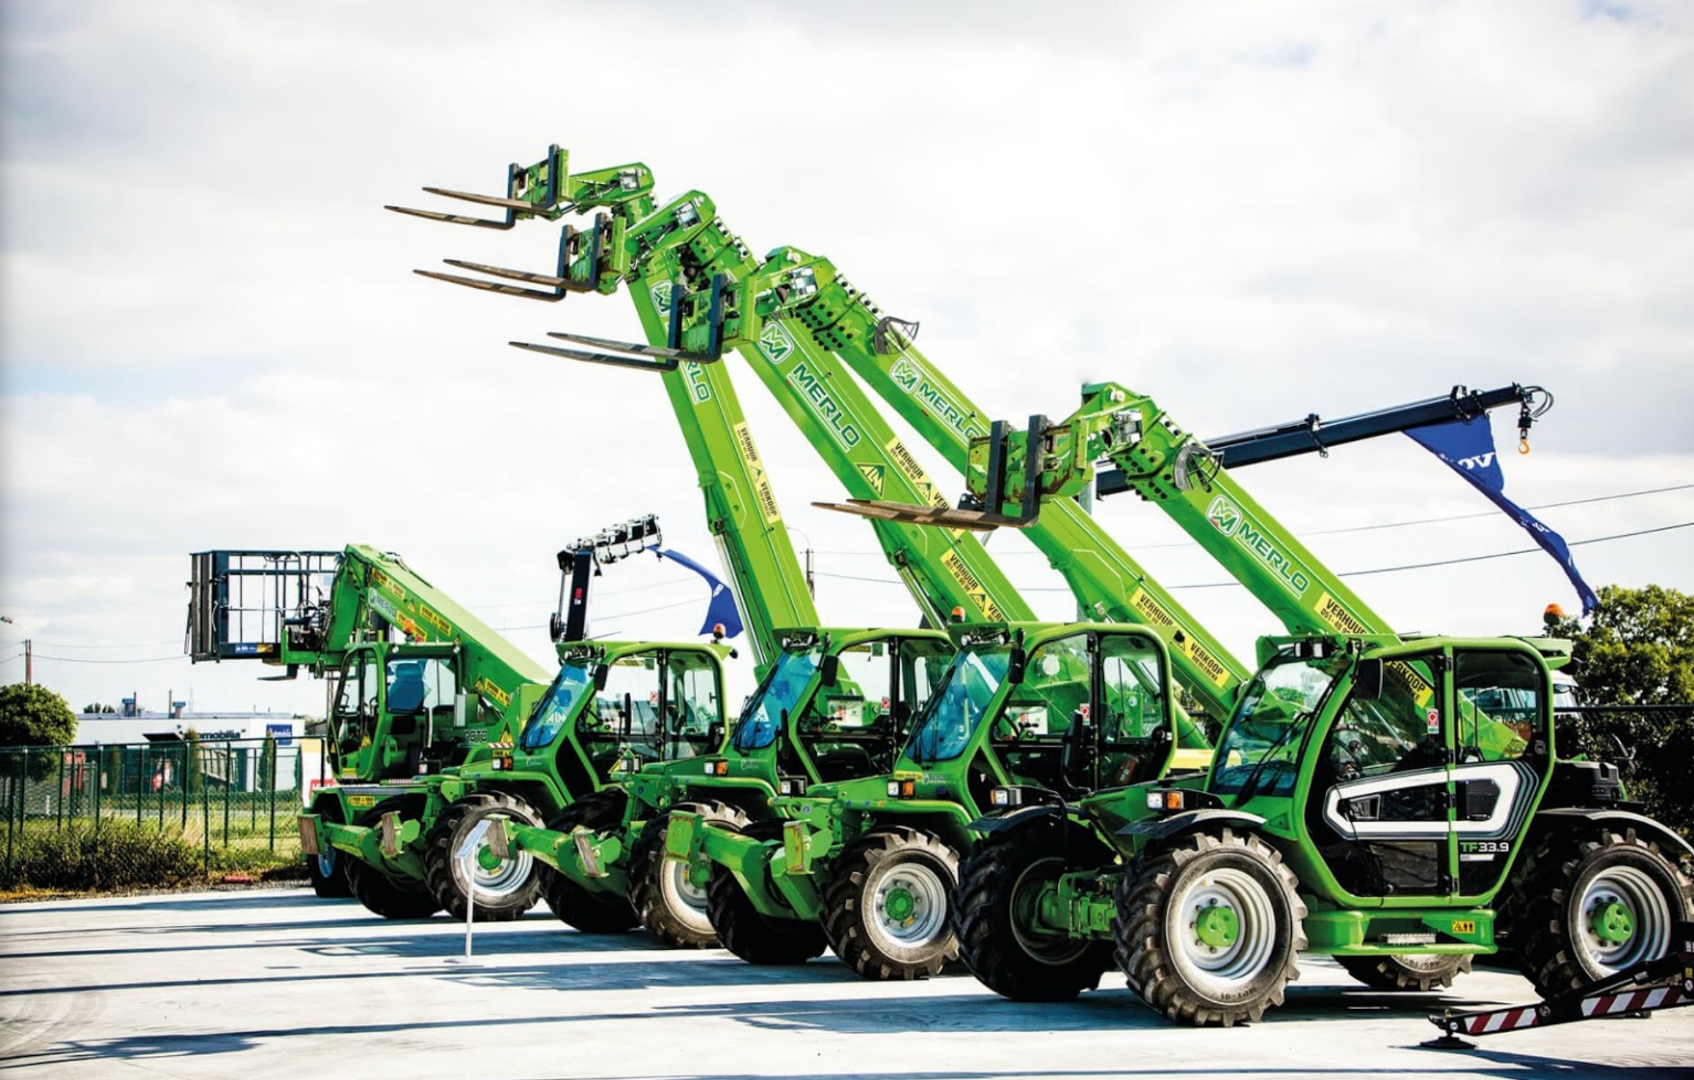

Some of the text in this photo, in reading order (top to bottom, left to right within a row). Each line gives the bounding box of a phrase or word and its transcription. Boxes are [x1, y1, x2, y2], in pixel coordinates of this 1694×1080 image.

[687, 361, 710, 401] RLO
[793, 363, 860, 447] MERLO
[895, 442, 923, 479] VERHUUR
[950, 554, 978, 590] VERHUUR
[1239, 521, 1309, 592] MERLO
[1190, 643, 1224, 675] VERKOOP
[1459, 842, 1510, 853] TF33.9
